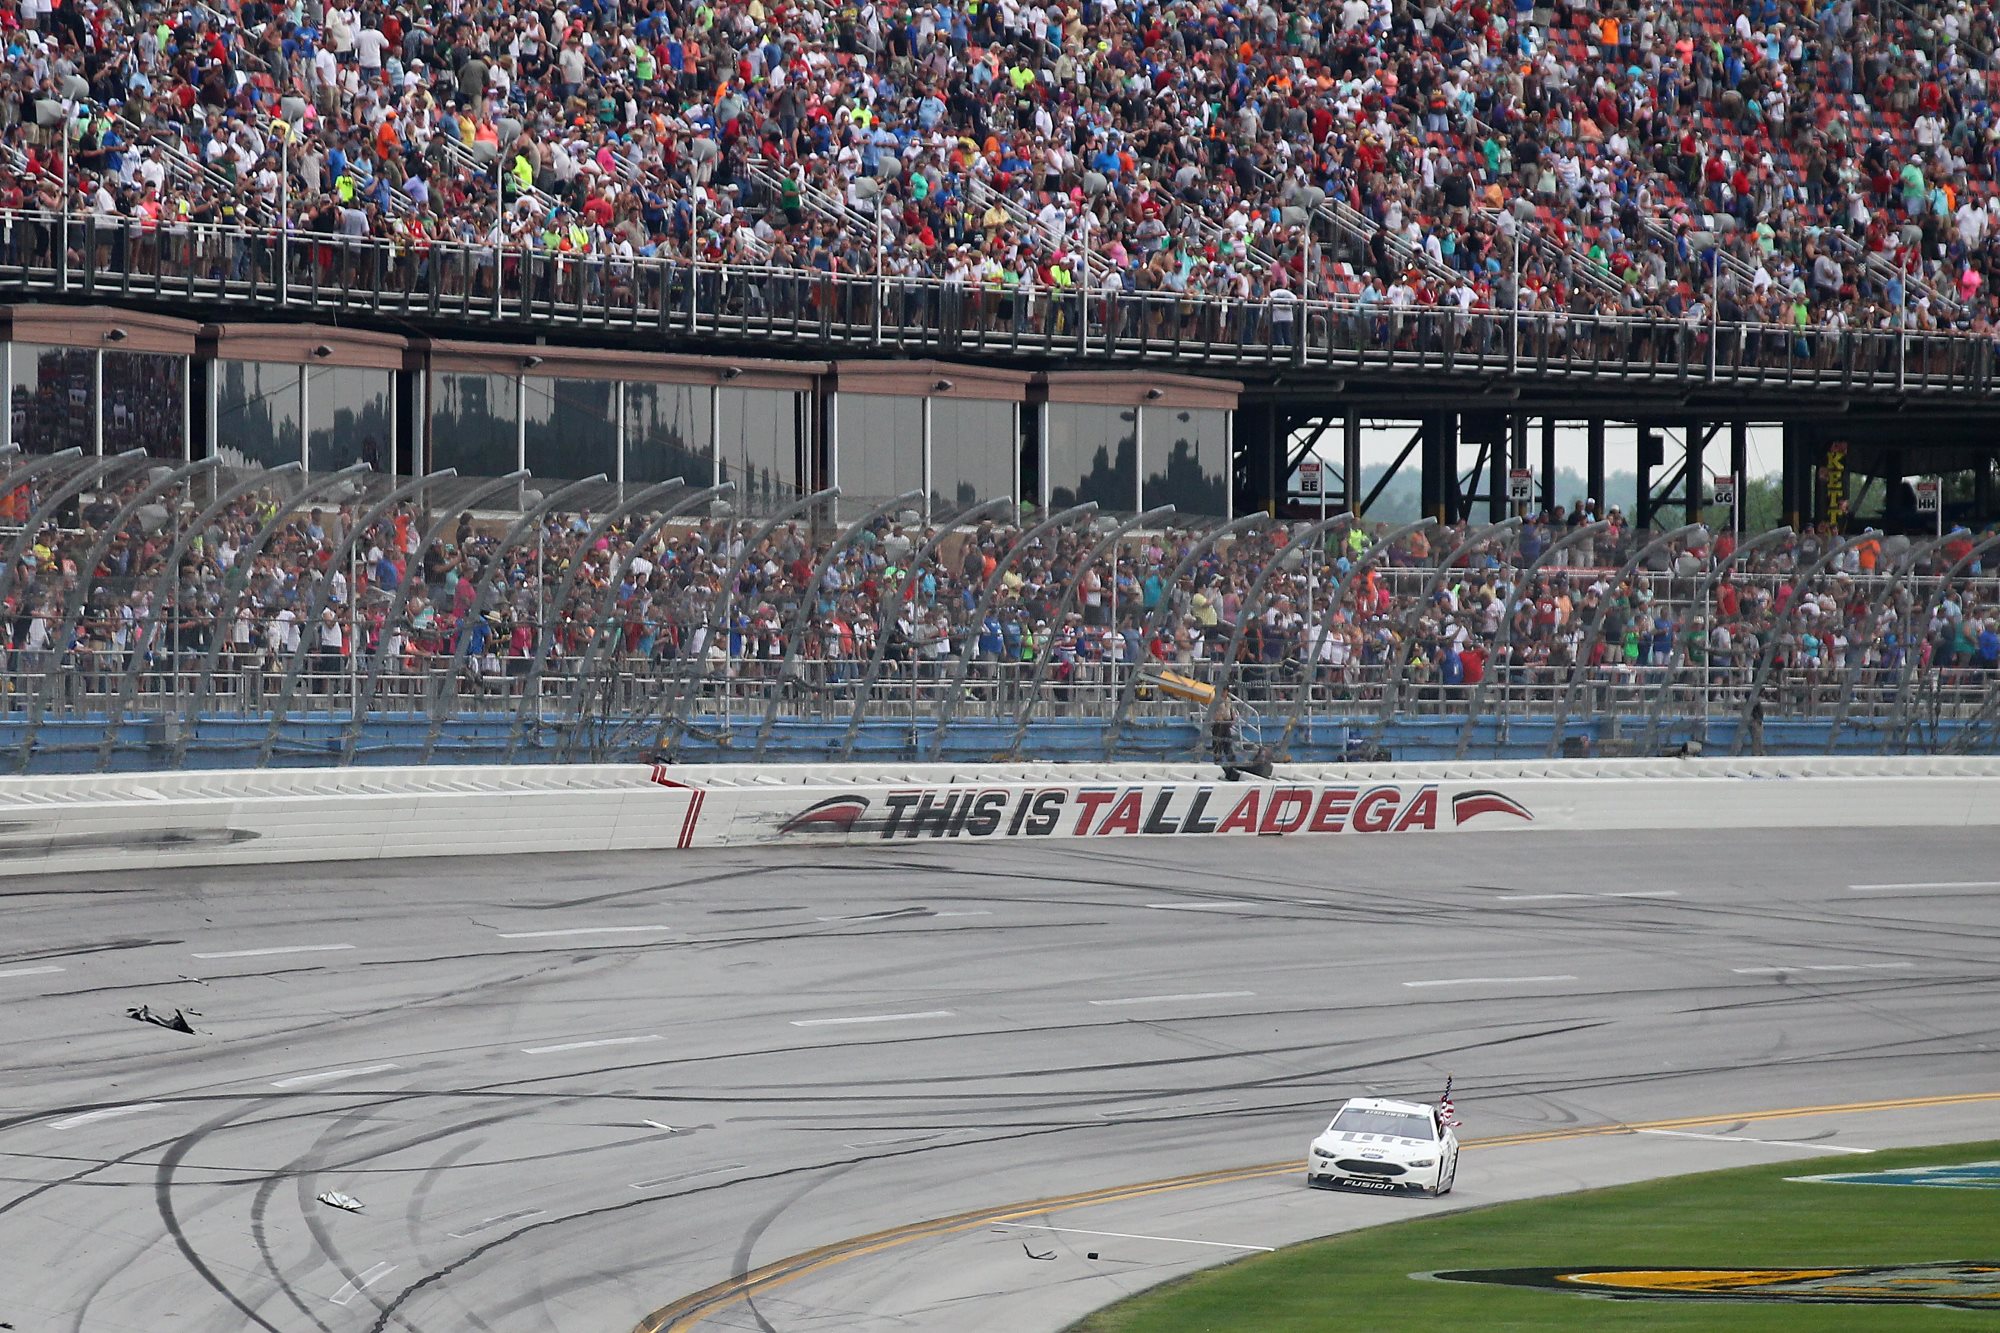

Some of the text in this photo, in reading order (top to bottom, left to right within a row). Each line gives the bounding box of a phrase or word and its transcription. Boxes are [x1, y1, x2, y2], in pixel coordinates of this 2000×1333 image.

[1302, 480, 1318, 492] EE
[1512, 486, 1528, 497] FF
[1827, 451, 1845, 525] KETT
[1715, 492, 1733, 503] GG
[1918, 498, 1936, 509] HH
[881, 785, 1439, 839] THIS IS TALLADEGA
[1343, 1180, 1395, 1190] FUSION
